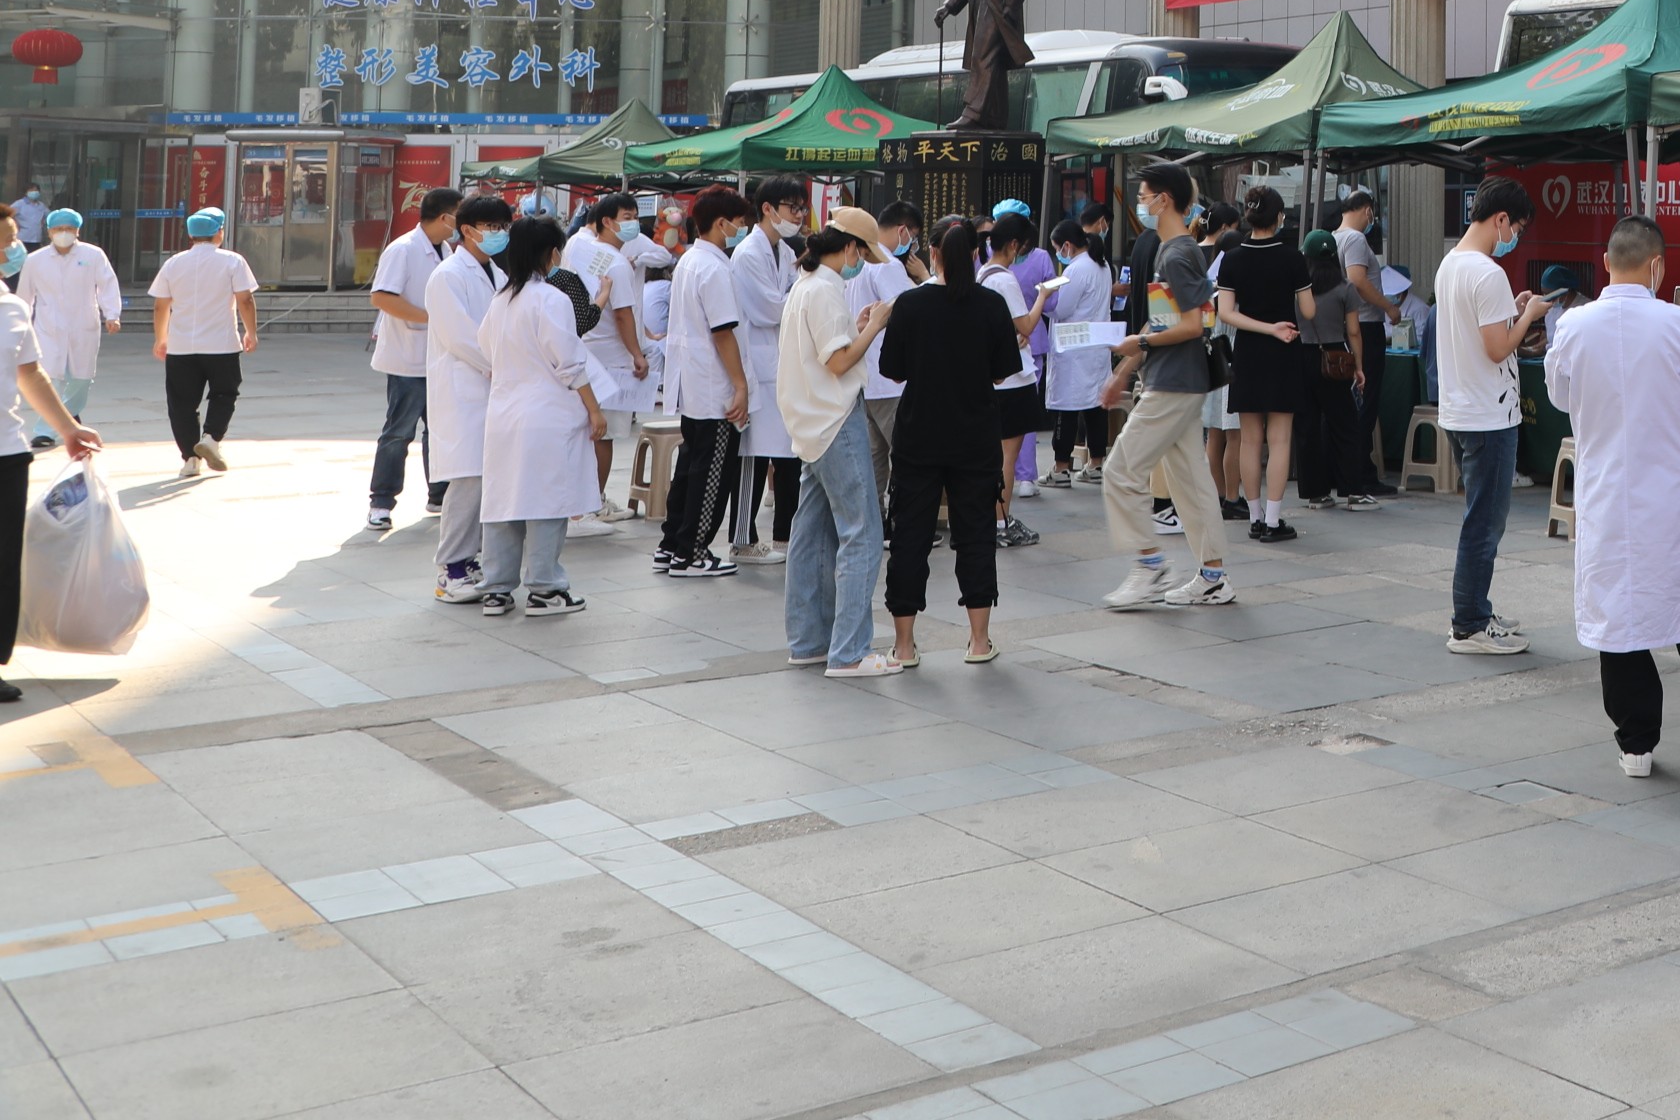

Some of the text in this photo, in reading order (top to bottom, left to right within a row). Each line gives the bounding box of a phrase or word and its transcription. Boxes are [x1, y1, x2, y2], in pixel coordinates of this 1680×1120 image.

[314, 44, 601, 93] 整形美容外科
[882, 142, 908, 164] 格物
[914, 140, 981, 163] 平天下
[1577, 206, 1610, 215] WUHAN
